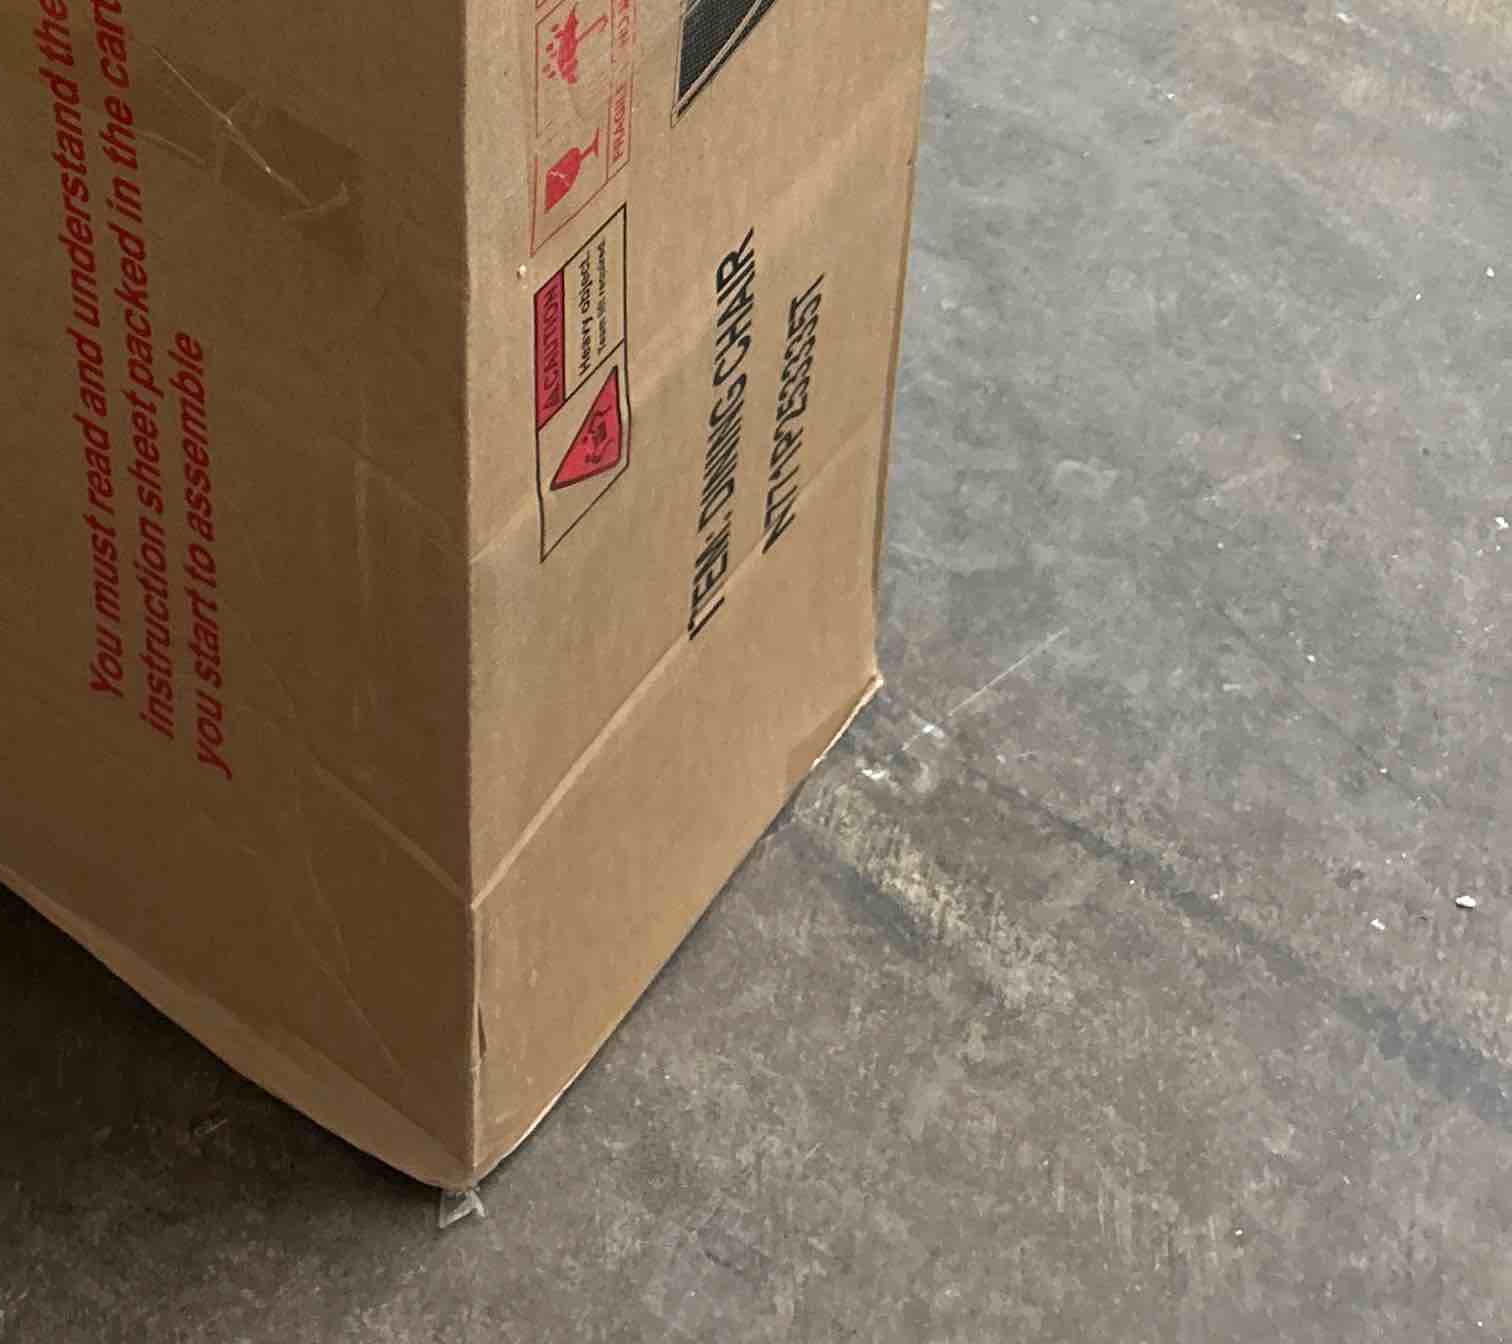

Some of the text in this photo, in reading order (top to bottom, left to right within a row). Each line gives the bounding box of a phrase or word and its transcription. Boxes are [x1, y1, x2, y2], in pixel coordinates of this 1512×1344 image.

[99, 95, 137, 171] the
[44, 67, 99, 328] understand
[105, 176, 143, 224] in
[66, 326, 107, 418] and
[107, 221, 164, 399] packed
[543, 282, 559, 392] CAUTION
[578, 247, 594, 377] Heavy object.
[72, 412, 115, 516] read
[121, 389, 164, 515] sheet
[688, 226, 755, 640] ITEM: DINING CHAIR
[761, 273, 825, 555] N771P253335T
[82, 513, 121, 624] must
[167, 331, 232, 781] you start to assemble
[89, 624, 124, 699] You
[132, 516, 174, 737] instruction
